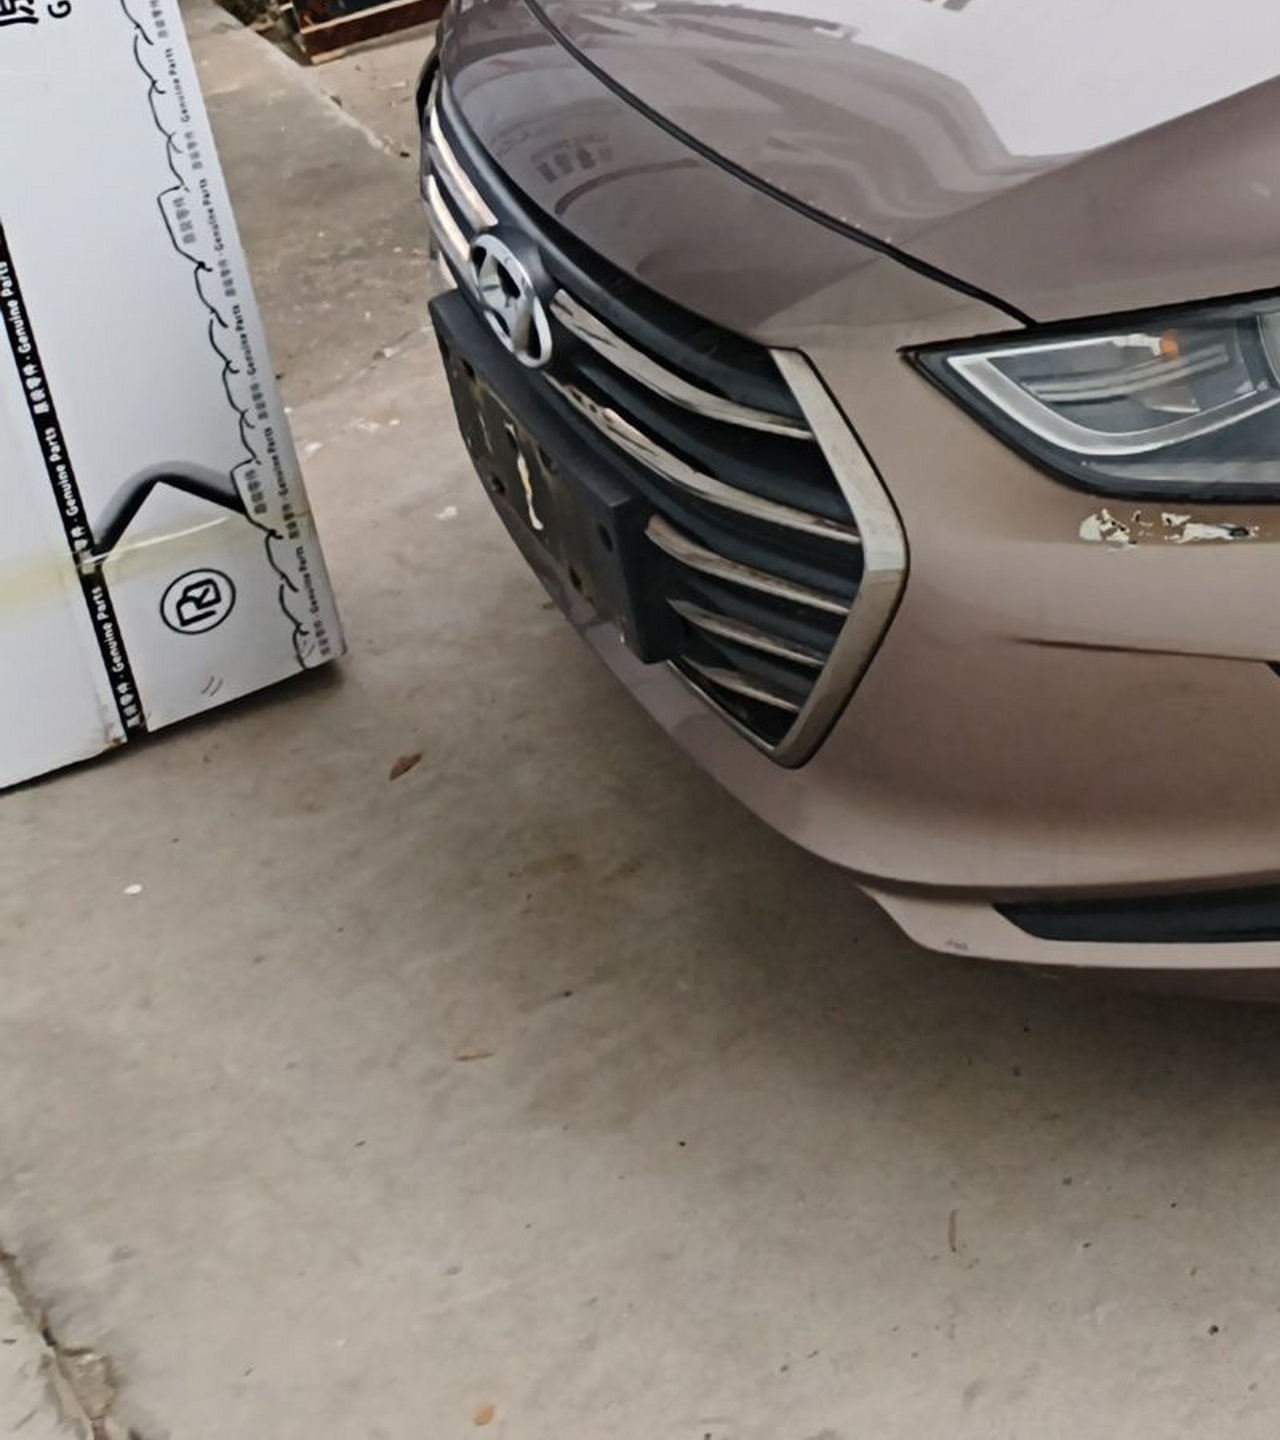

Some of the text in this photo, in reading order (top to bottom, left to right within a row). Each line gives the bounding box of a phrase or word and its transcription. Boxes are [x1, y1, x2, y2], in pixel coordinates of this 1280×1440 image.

[165, 47, 178, 76] Parts
[173, 77, 190, 123] Genuine
[199, 178, 212, 207] Parts
[206, 208, 224, 252] Genuine
[8, 299, 31, 353] Genuine
[232, 304, 245, 332] Parts
[239, 333, 257, 377] Genuine
[45, 427, 62, 462] Parts
[264, 426, 277, 454] Parts
[56, 463, 79, 516] Genuine
[271, 454, 289, 497] Genuine
[91, 586, 110, 621] Parts
[102, 621, 125, 673] Genuine
